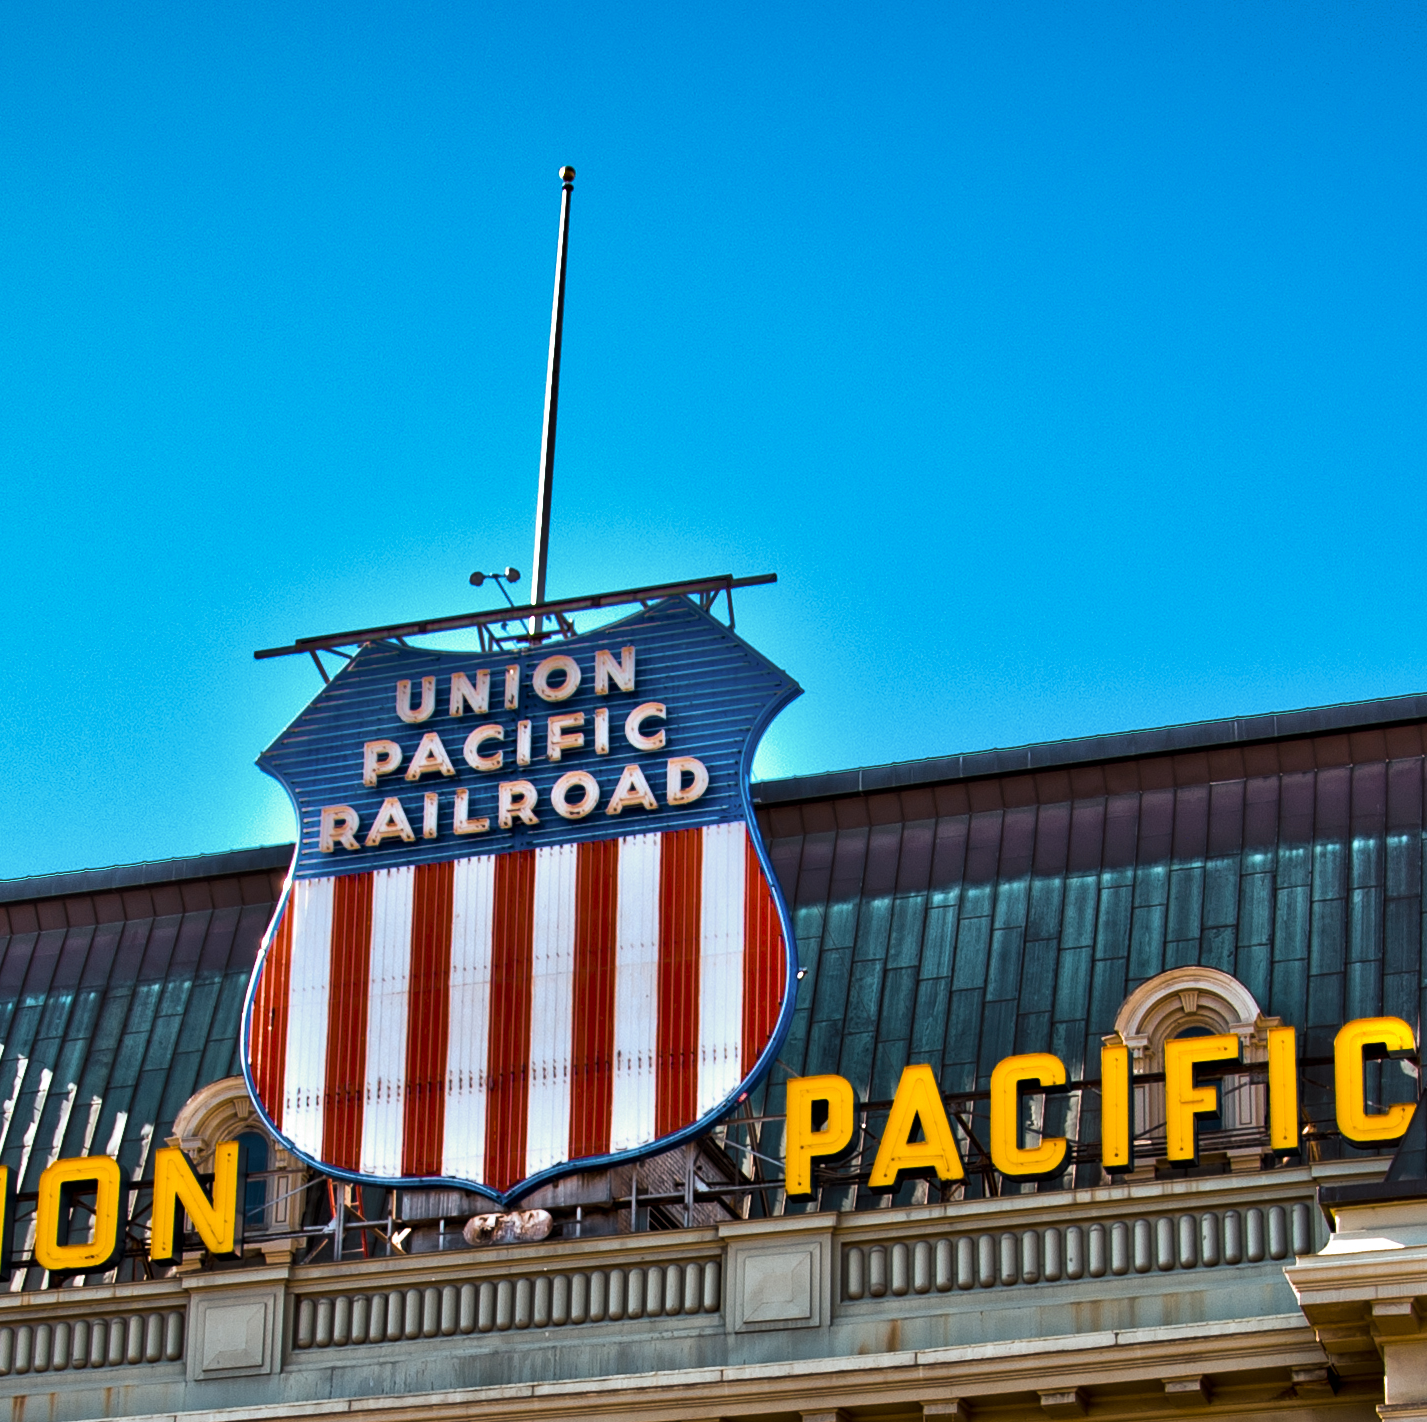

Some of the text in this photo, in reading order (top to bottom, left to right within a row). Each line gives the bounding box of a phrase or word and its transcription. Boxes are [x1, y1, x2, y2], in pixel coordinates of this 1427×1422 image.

[396, 646, 635, 724] UNION
[362, 701, 667, 787] PACIFIC
[318, 756, 710, 853] RAILROAD
[785, 1016, 1417, 1197] PACIFIC
